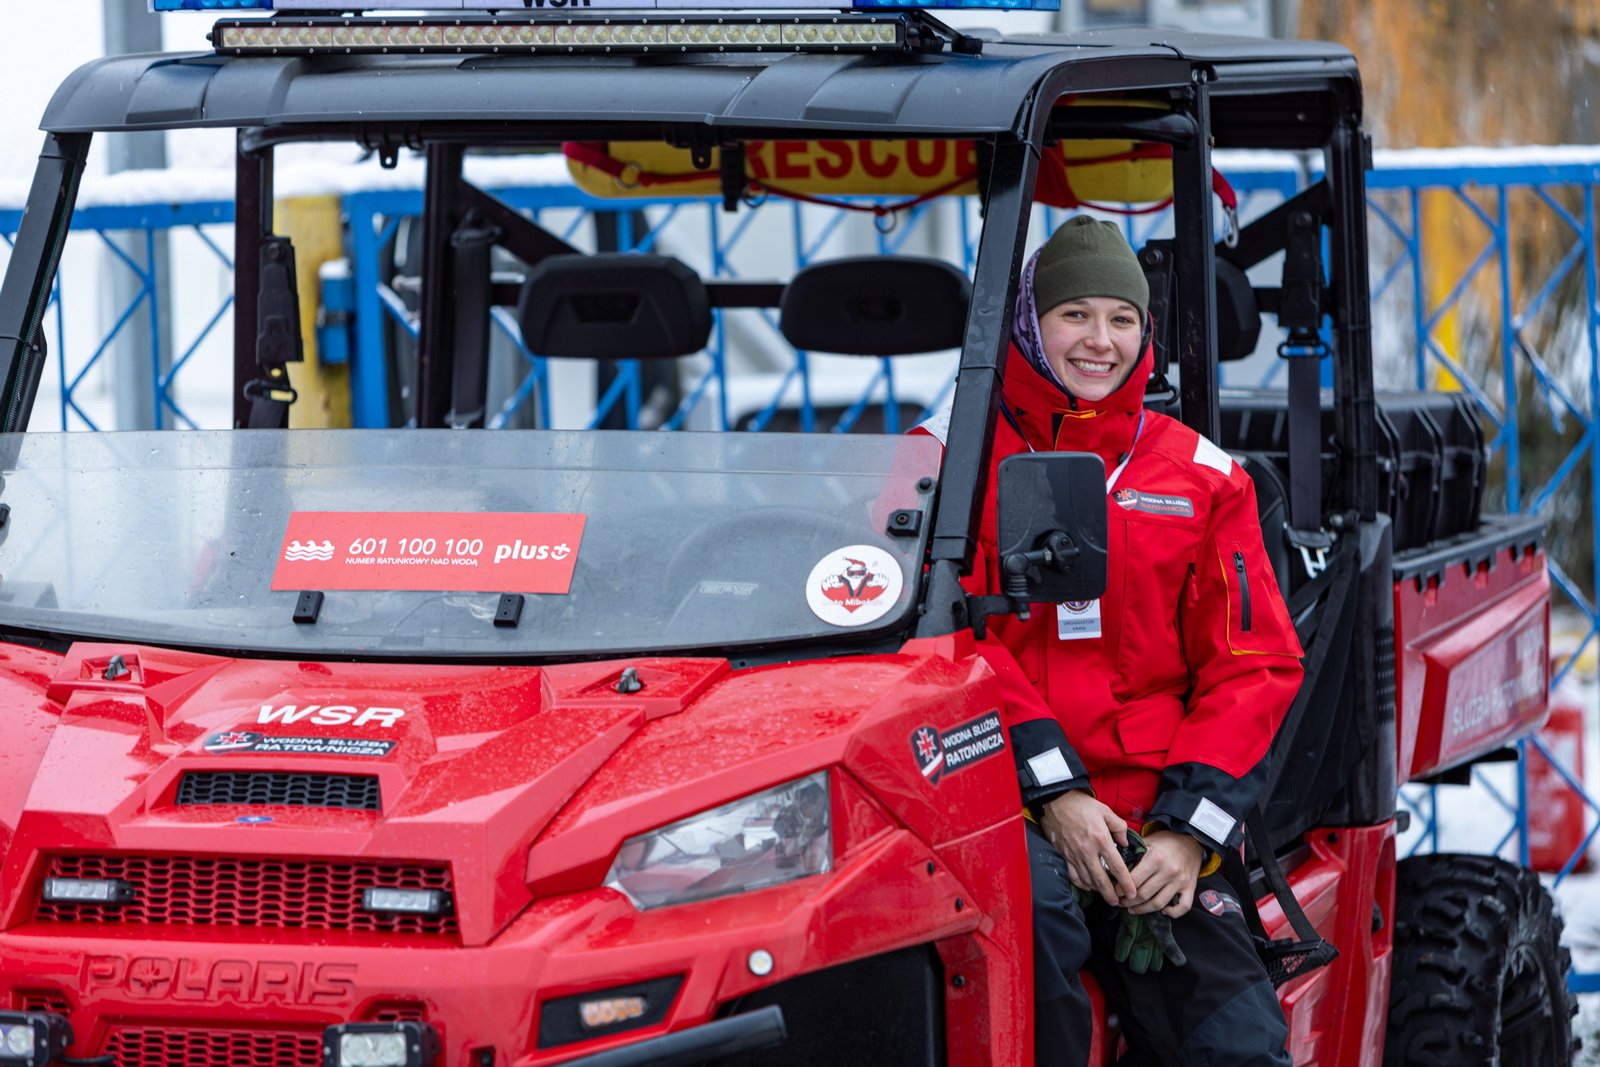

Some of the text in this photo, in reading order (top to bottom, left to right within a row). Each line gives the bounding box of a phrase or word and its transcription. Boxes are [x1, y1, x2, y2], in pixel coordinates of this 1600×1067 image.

[348, 538, 484, 556] 601 100 100
[493, 539, 550, 564] plus
[345, 557, 478, 567] NUMER RATUNKOWY NAD WODĄ
[256, 705, 405, 728] WSR
[942, 718, 999, 748] WODNA SŁUŻBA
[254, 744, 385, 756] RATOWNICZA
[945, 733, 1004, 766] RATOWNICZA
[79, 954, 358, 1006] POLARIS
